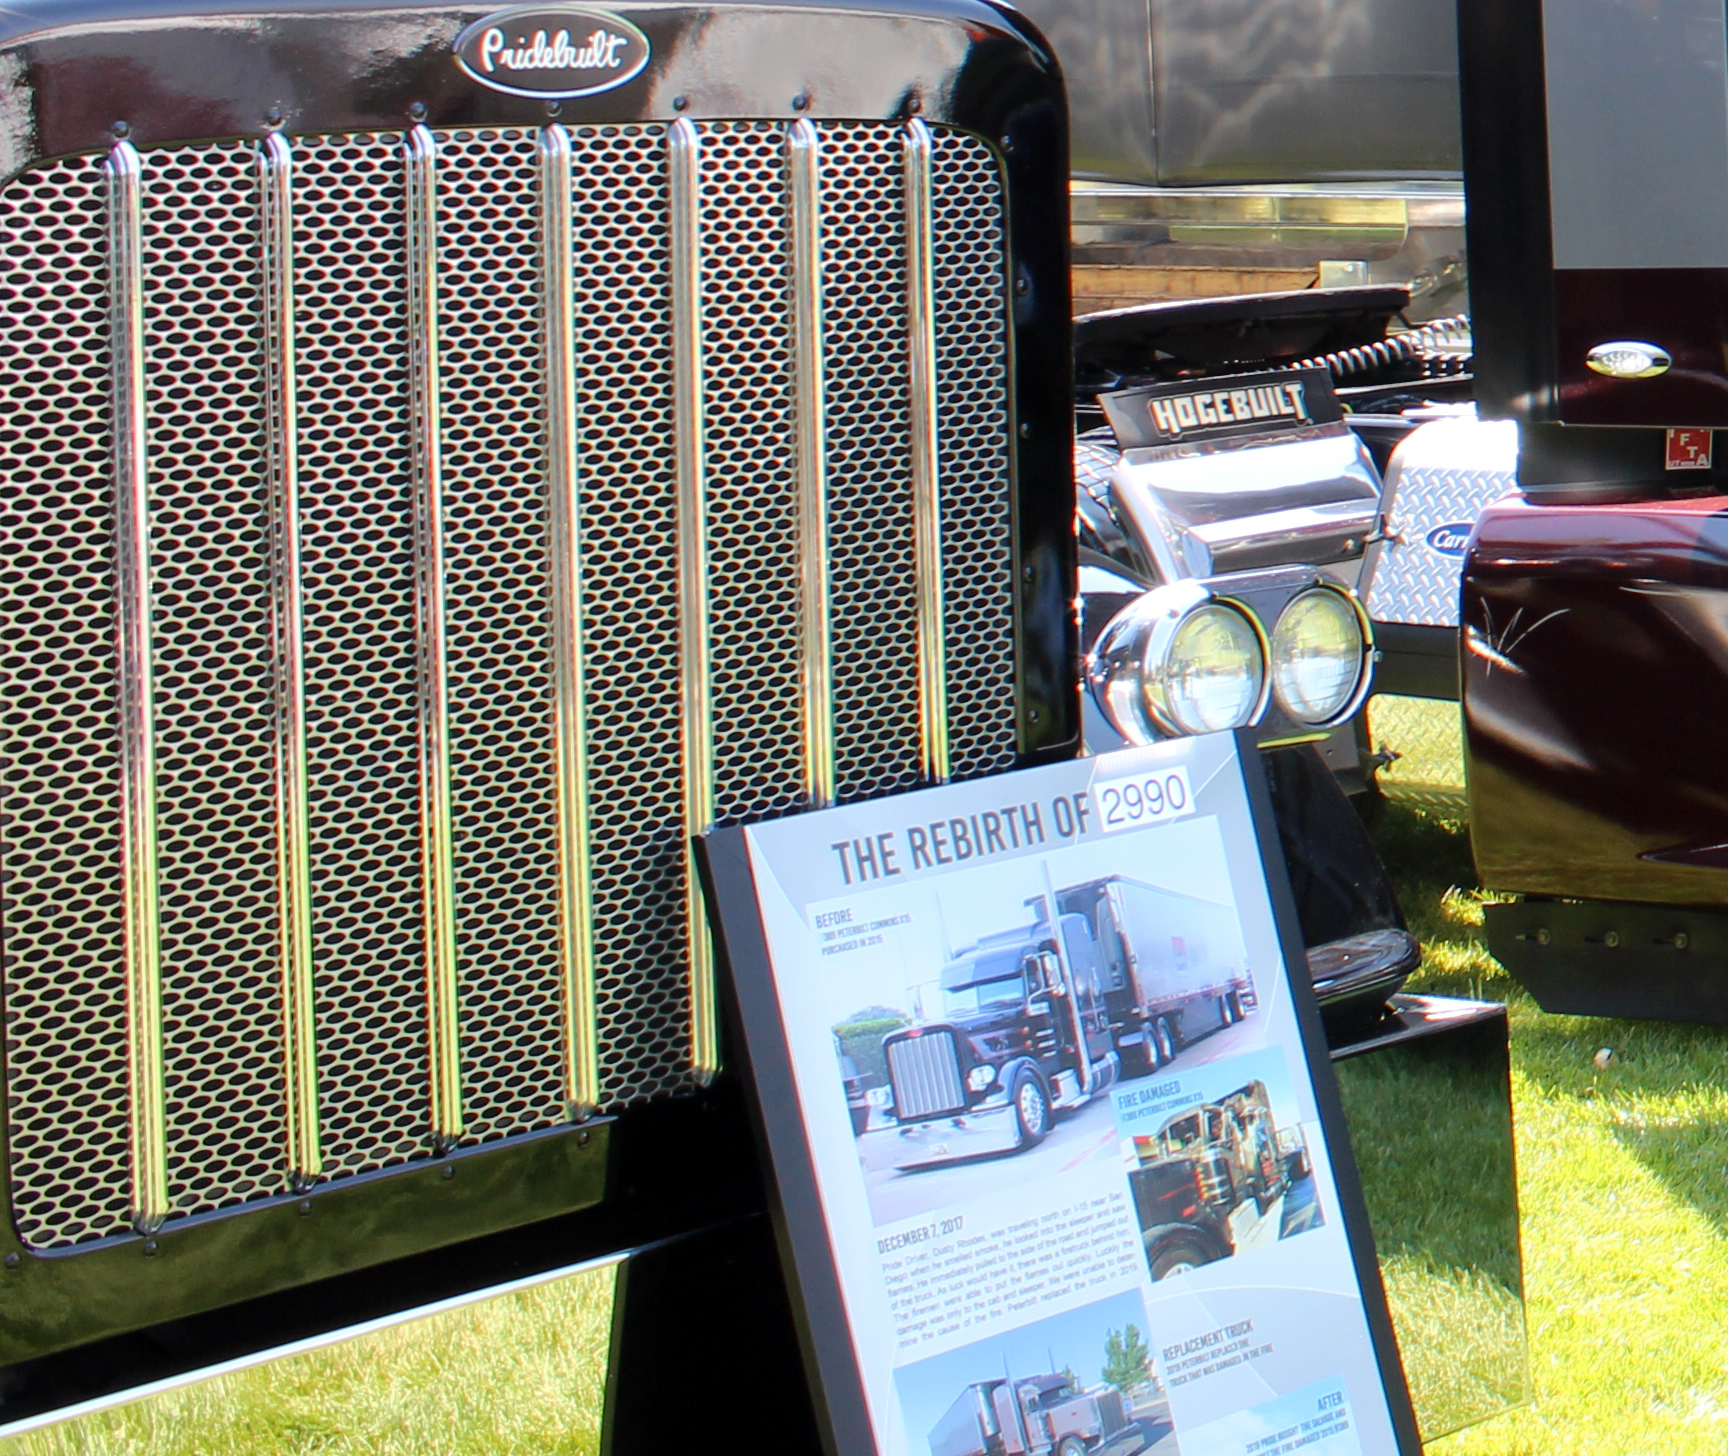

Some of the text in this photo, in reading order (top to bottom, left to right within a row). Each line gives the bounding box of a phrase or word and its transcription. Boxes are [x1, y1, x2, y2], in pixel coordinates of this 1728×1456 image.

[480, 27, 629, 73] Pridebuilt
[1150, 382, 1309, 434] HOGEBUILT
[831, 774, 1186, 885] THE REBIRTH OF 2990
[815, 908, 853, 929] BEFORE
[1118, 1080, 1181, 1110] FIRE DAMAGED
[878, 1216, 964, 1254] DECEMBER 7, 2017
[881, 1261, 902, 1271] Pride
[1162, 1318, 1254, 1362] REPLACEMENT TRUCK
[1317, 1391, 1344, 1412] AFTER
